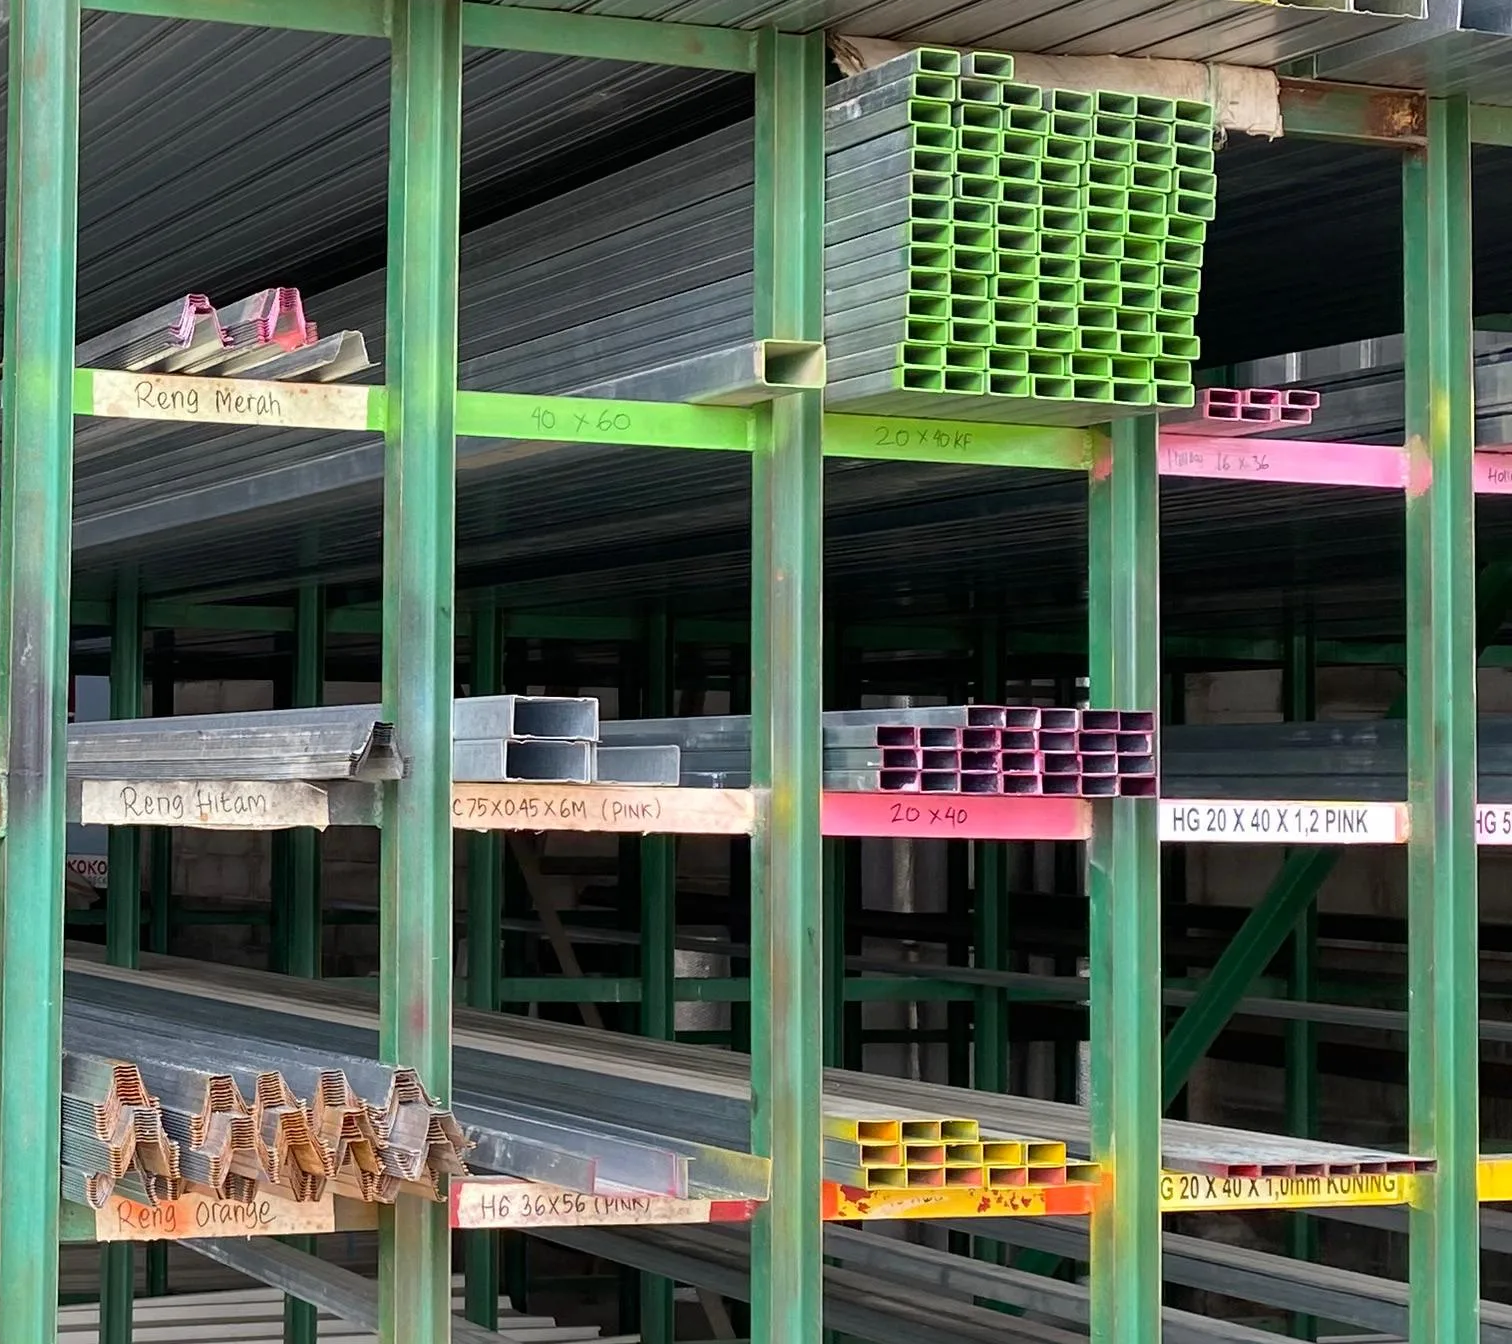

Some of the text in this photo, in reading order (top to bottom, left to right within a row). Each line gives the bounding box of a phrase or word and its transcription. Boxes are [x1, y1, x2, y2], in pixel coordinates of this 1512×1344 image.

[134, 380, 281, 416] Reng Merah
[531, 406, 555, 432] 40
[596, 409, 631, 431] 60
[875, 426, 909, 447] 20
[1253, 455, 1270, 471] 36
[120, 780, 267, 819] Reng Hitam
[601, 797, 662, 823] (PINK)
[890, 803, 920, 824] 20
[1173, 807, 1369, 836] HG 20 X 40 X 1,2 PINK
[1180, 1175, 1198, 1199] 20
[1205, 1176, 1217, 1199] X
[1223, 1176, 1242, 1198] 40
[1248, 1176, 1260, 1197] X
[117, 1199, 176, 1232] Reng
